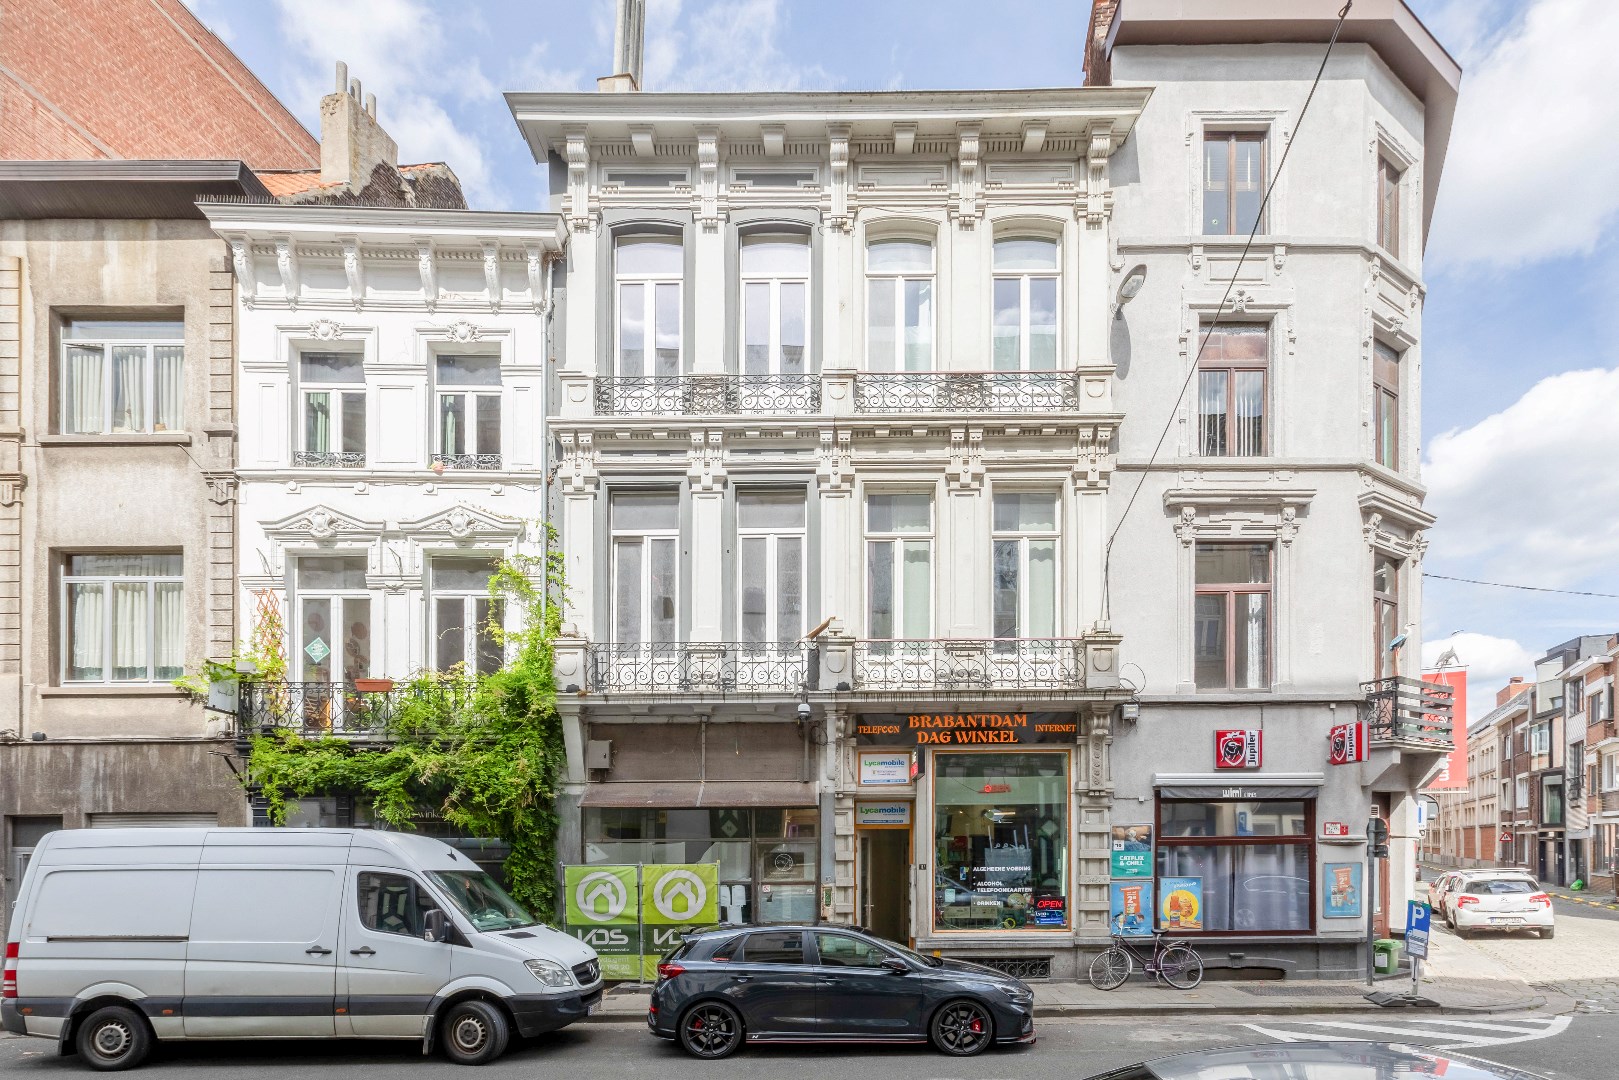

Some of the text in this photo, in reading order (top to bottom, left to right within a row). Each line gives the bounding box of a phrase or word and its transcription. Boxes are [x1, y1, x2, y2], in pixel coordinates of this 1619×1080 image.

[908, 714, 1027, 728] BRABANTDAM
[857, 725, 900, 734] TELEFOON
[1035, 724, 1076, 732] INTERNET
[917, 730, 1018, 743] DAG WINKEL
[1347, 725, 1355, 759] Jupiler
[1247, 732, 1257, 765] Jupiler
[864, 759, 905, 767] Lycamobile
[860, 806, 906, 815] Lycamobile
[1038, 900, 1064, 908] OPEN
[1411, 904, 1425, 927] P
[577, 929, 629, 945] VDS
